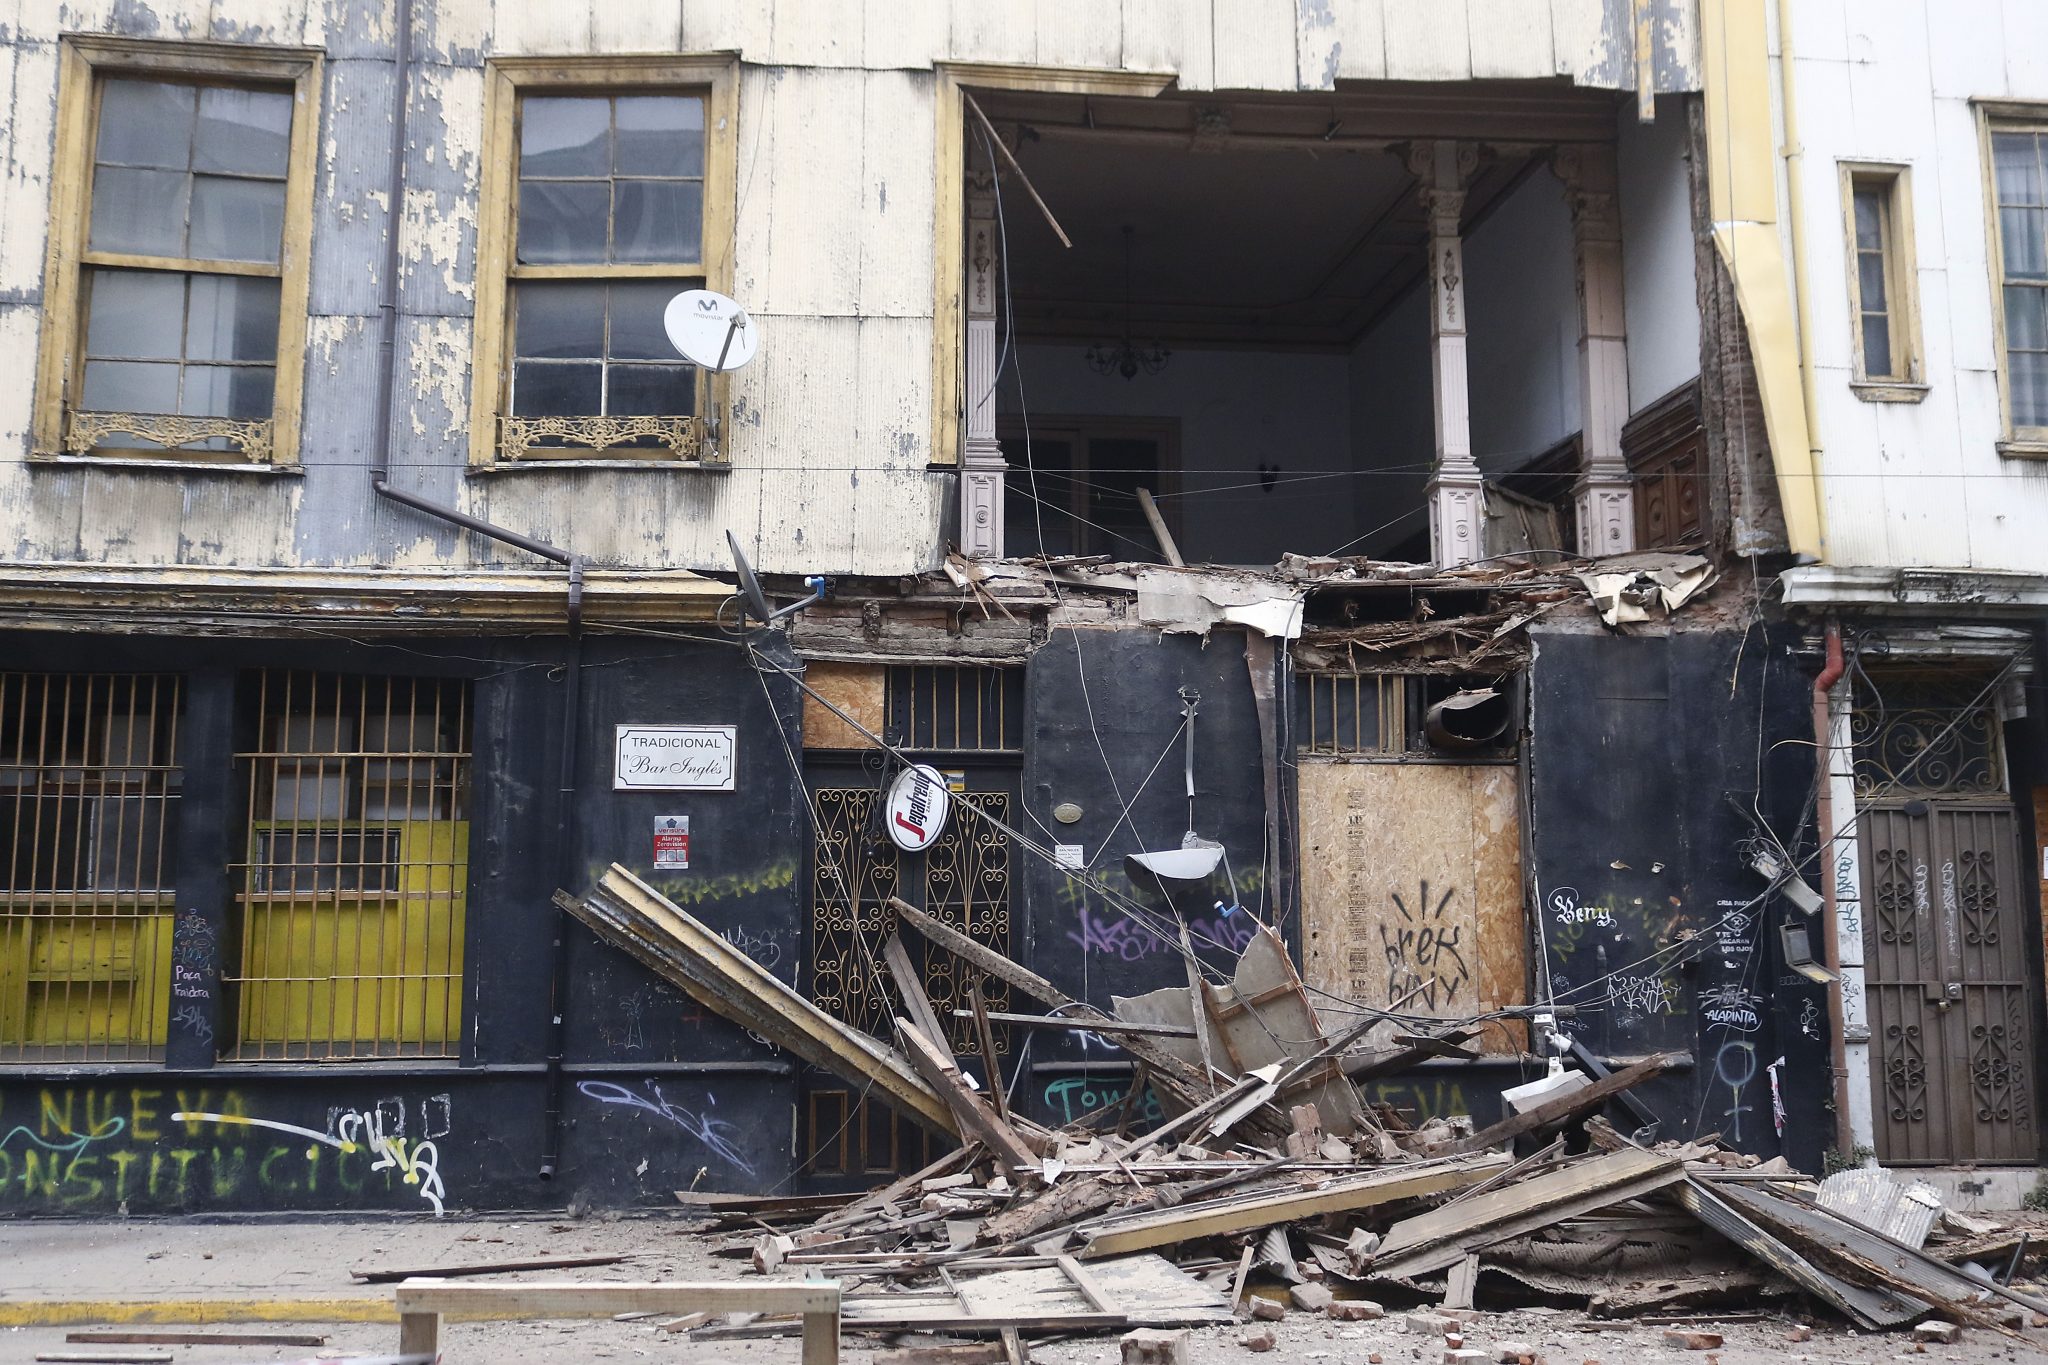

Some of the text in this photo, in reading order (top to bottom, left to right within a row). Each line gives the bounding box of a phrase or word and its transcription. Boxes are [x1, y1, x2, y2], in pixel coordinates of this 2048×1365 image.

[693, 312, 724, 321] movistar
[631, 737, 721, 749] TRADICIONAL
[896, 771, 930, 844] Segafredo
[925, 788, 934, 813] ZANETTI
[40, 1088, 247, 1139] NUEVA
